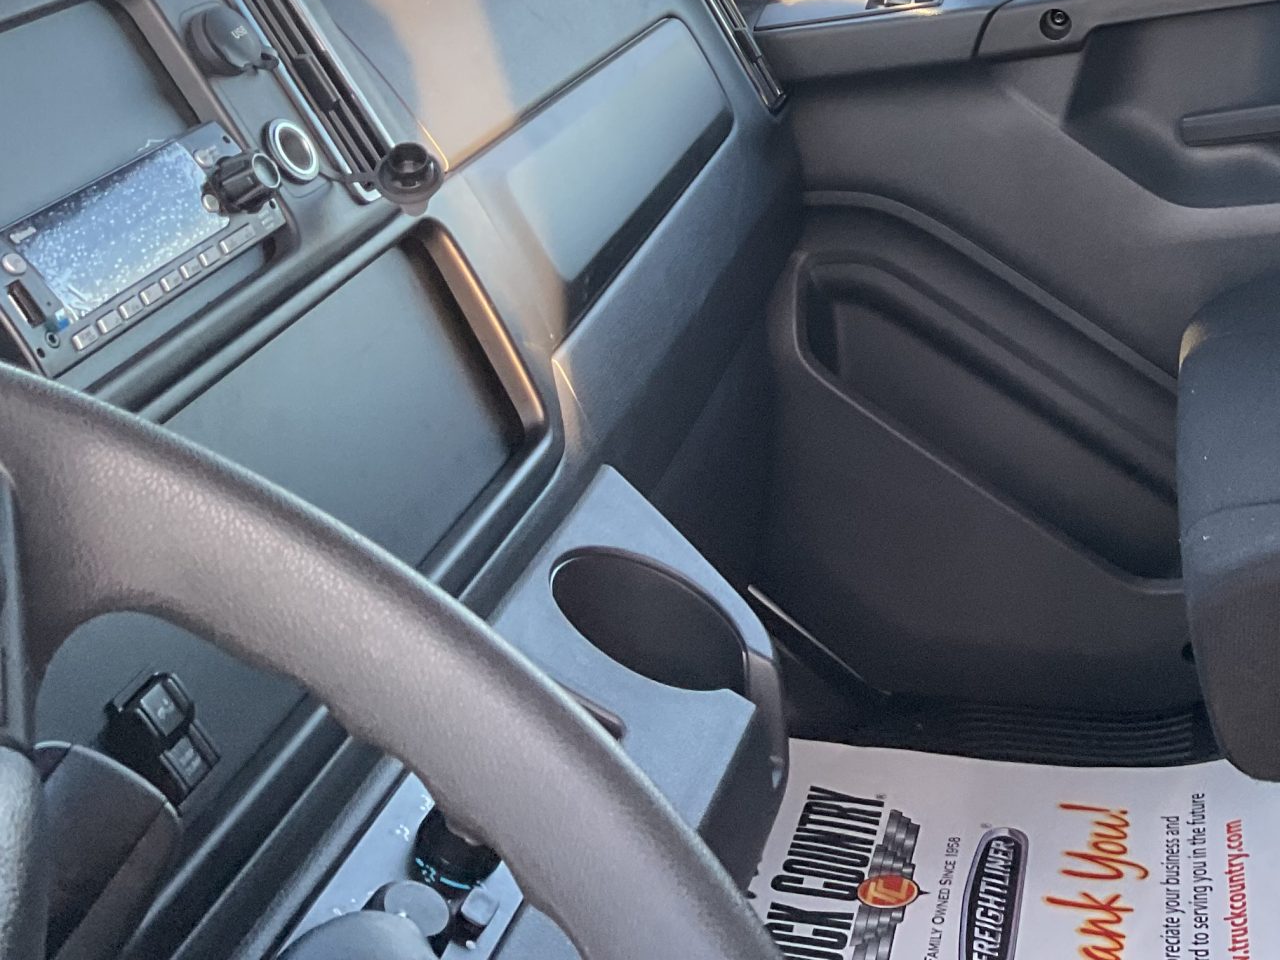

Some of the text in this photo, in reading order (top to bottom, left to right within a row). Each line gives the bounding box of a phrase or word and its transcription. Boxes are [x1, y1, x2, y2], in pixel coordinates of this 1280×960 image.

[1186, 792, 1206, 826] future
[1161, 815, 1180, 835] and
[1187, 827, 1206, 846] the
[771, 785, 885, 901] COUNTRY
[945, 837, 961, 857] 1958
[1060, 802, 1149, 880] You!
[1187, 847, 1207, 859] in
[939, 860, 956, 886] SINCE
[1160, 837, 1181, 885] business
[1192, 861, 1213, 883] you
[932, 887, 951, 924] OWNED
[972, 839, 1015, 960] FREIGHTLINER
[1165, 888, 1186, 914] your
[1188, 886, 1213, 929] serving
[1192, 933, 1209, 945] to
